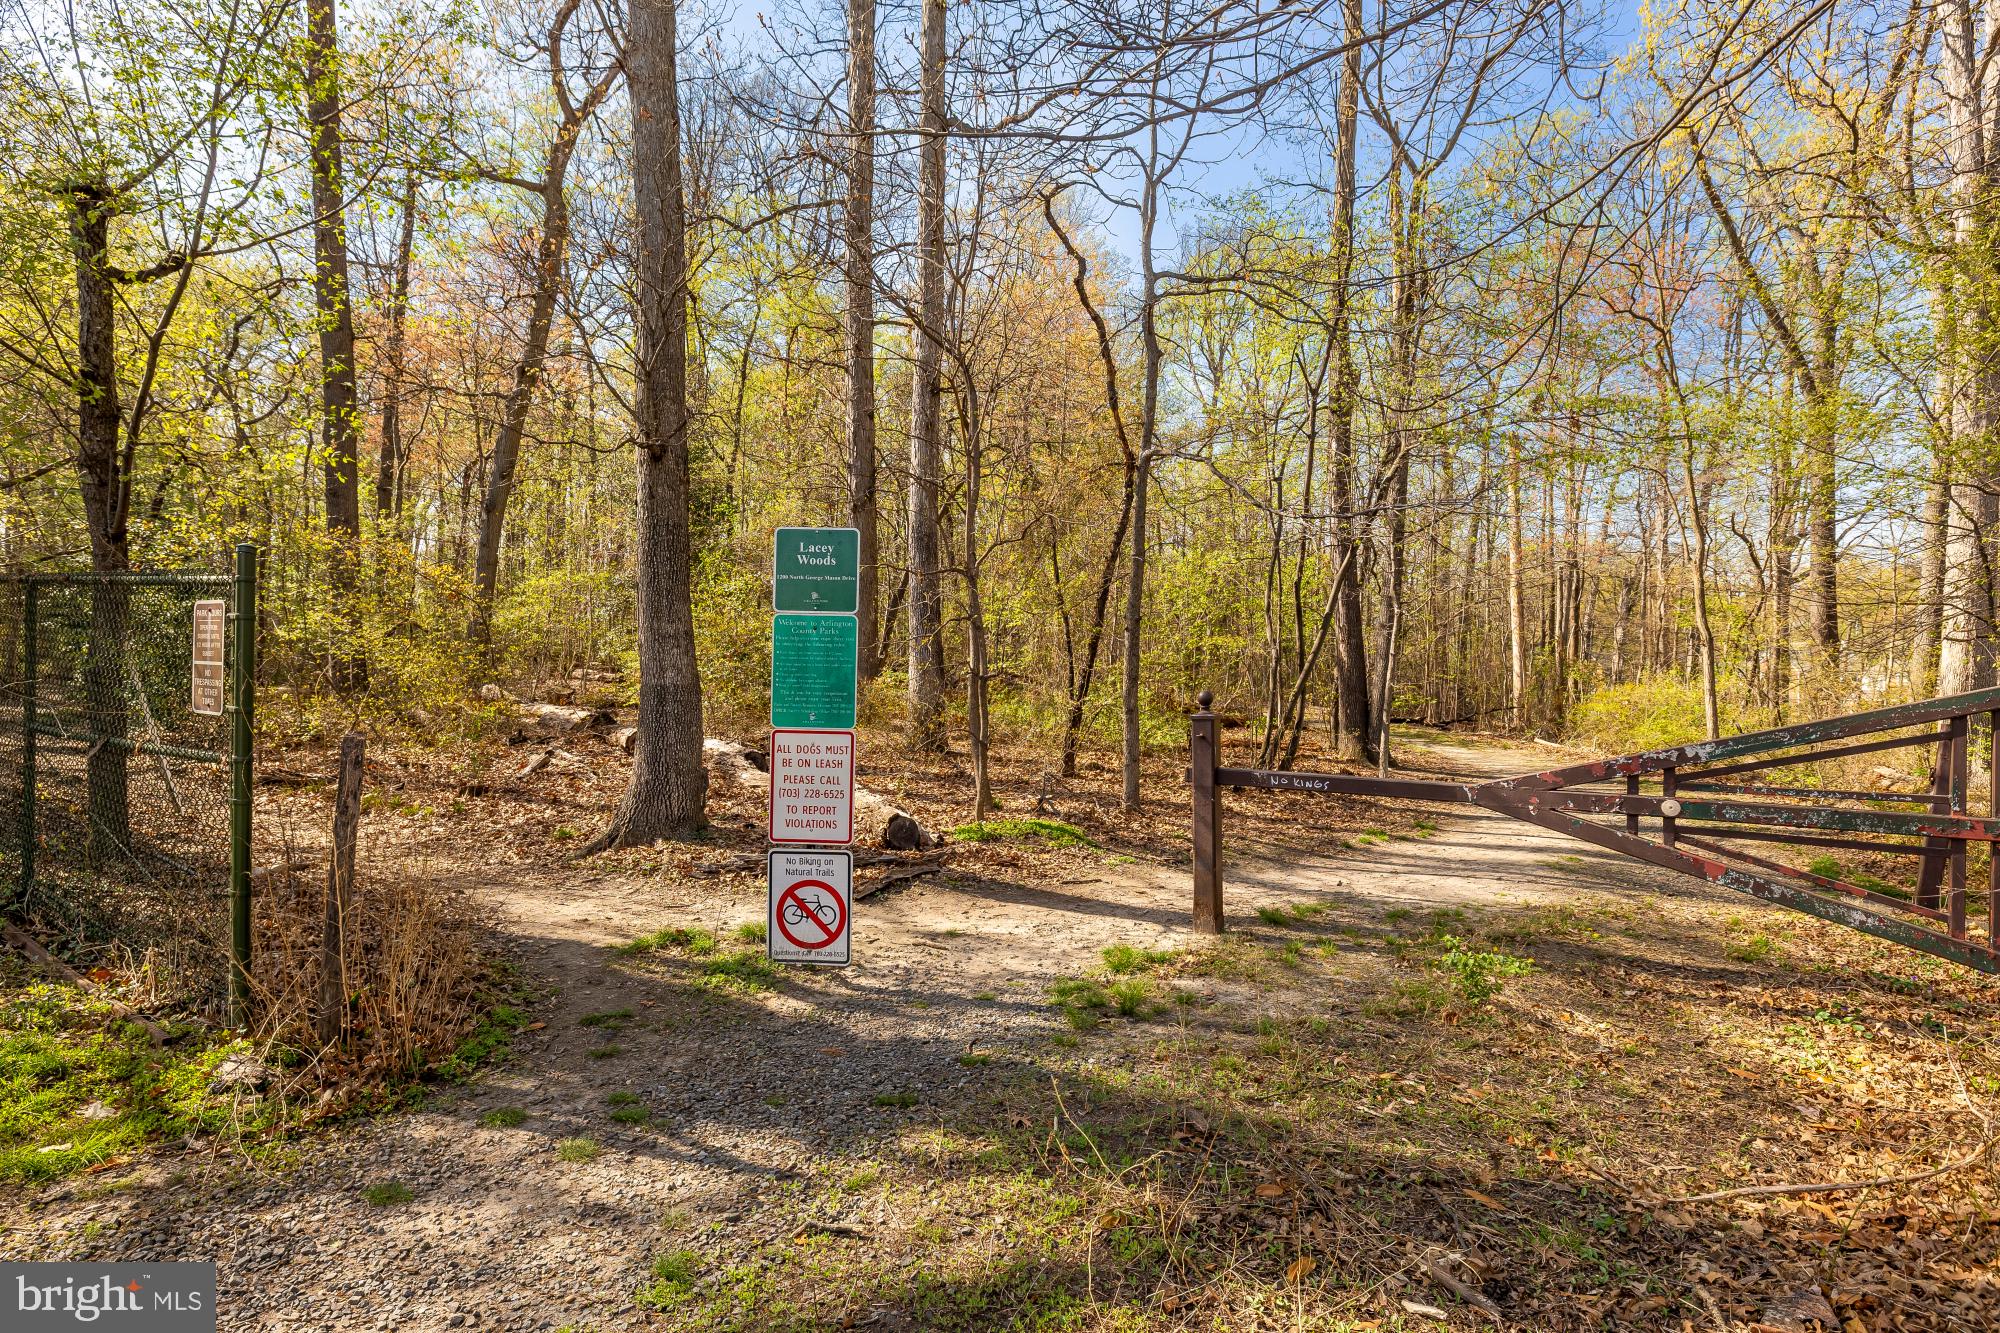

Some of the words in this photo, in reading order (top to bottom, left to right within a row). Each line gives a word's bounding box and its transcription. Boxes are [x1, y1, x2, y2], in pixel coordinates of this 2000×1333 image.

[800, 542, 834, 555] Lacey
[797, 554, 836, 566] Woods
[208, 609, 222, 617] OURS
[778, 618, 808, 626] Welcome
[820, 619, 853, 628] Arlington
[791, 626, 816, 635] County
[819, 627, 839, 635] Parks
[205, 669, 212, 677] NO
[194, 677, 222, 687] TRESPASSING
[198, 687, 203, 695] AT
[205, 688, 217, 696] OTHER
[776, 744, 791, 754] ALL
[796, 744, 821, 755] DOGS
[825, 745, 849, 755] MUST
[782, 758, 792, 768] BE
[797, 758, 811, 768] ON
[815, 759, 843, 769] LEASH
[783, 774, 815, 785] PLEASE
[819, 775, 841, 785] CALL
[1270, 775, 1288, 786] NO
[1293, 777, 1330, 790] KINGS
[778, 788, 800, 799] (703)
[804, 788, 845, 800] 228-6525
[786, 804, 798, 815] TO
[802, 805, 837, 816] REPORT
[785, 818, 838, 830] VIOLATIONS
[786, 857, 797, 865] No
[799, 857, 821, 867] Biking
[824, 858, 834, 866] on
[785, 868, 813, 876] Natural
[815, 868, 835, 877] Trails
